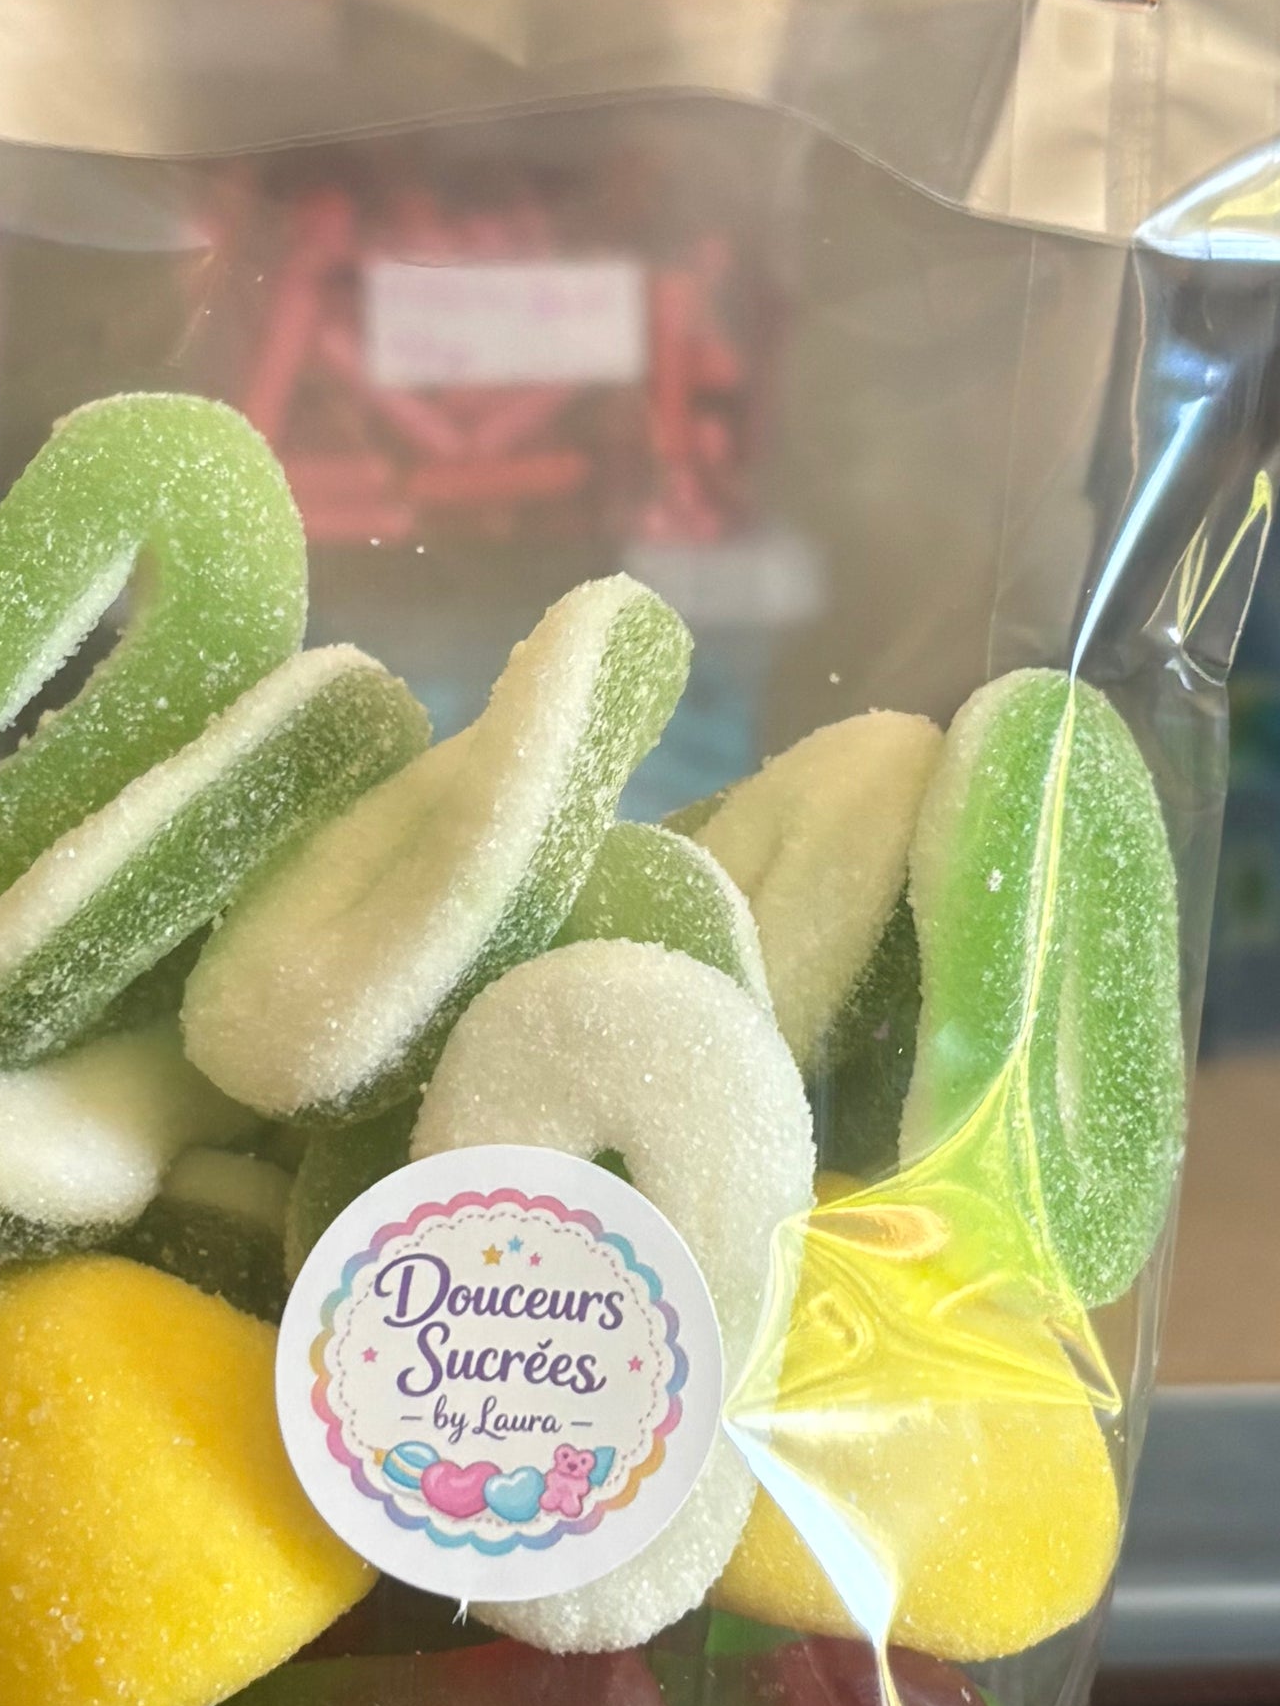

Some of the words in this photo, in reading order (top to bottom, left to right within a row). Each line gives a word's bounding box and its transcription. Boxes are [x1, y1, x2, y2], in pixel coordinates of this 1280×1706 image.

[374, 1253, 624, 1331] Douceurs
[432, 1394, 468, 1443] by
[473, 1396, 563, 1440] Laura
